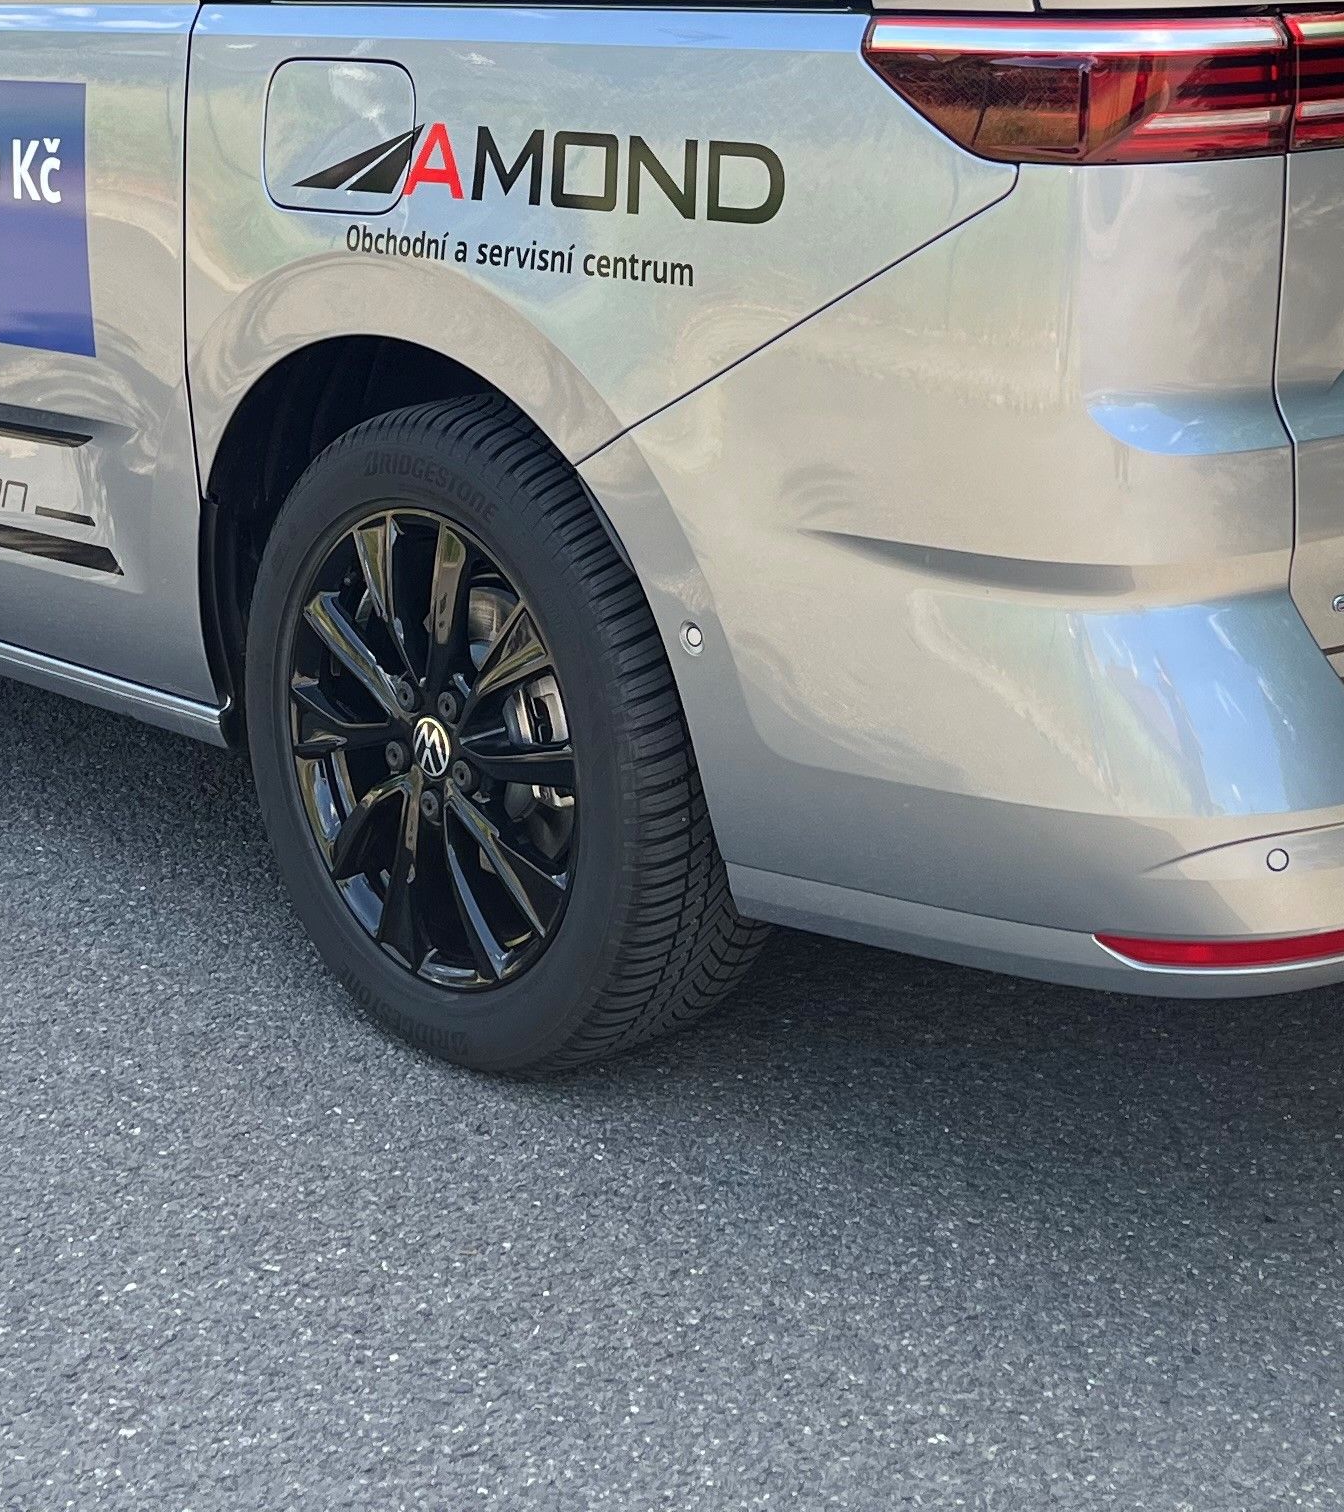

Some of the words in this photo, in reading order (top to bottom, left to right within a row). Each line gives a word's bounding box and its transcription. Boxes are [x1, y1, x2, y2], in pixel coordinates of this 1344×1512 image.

[12, 138, 62, 203] Kč
[403, 121, 785, 225] AMOND
[346, 224, 448, 262] Obchodní
[455, 241, 469, 263] a
[476, 239, 574, 274] servisní
[583, 249, 694, 287] centrum
